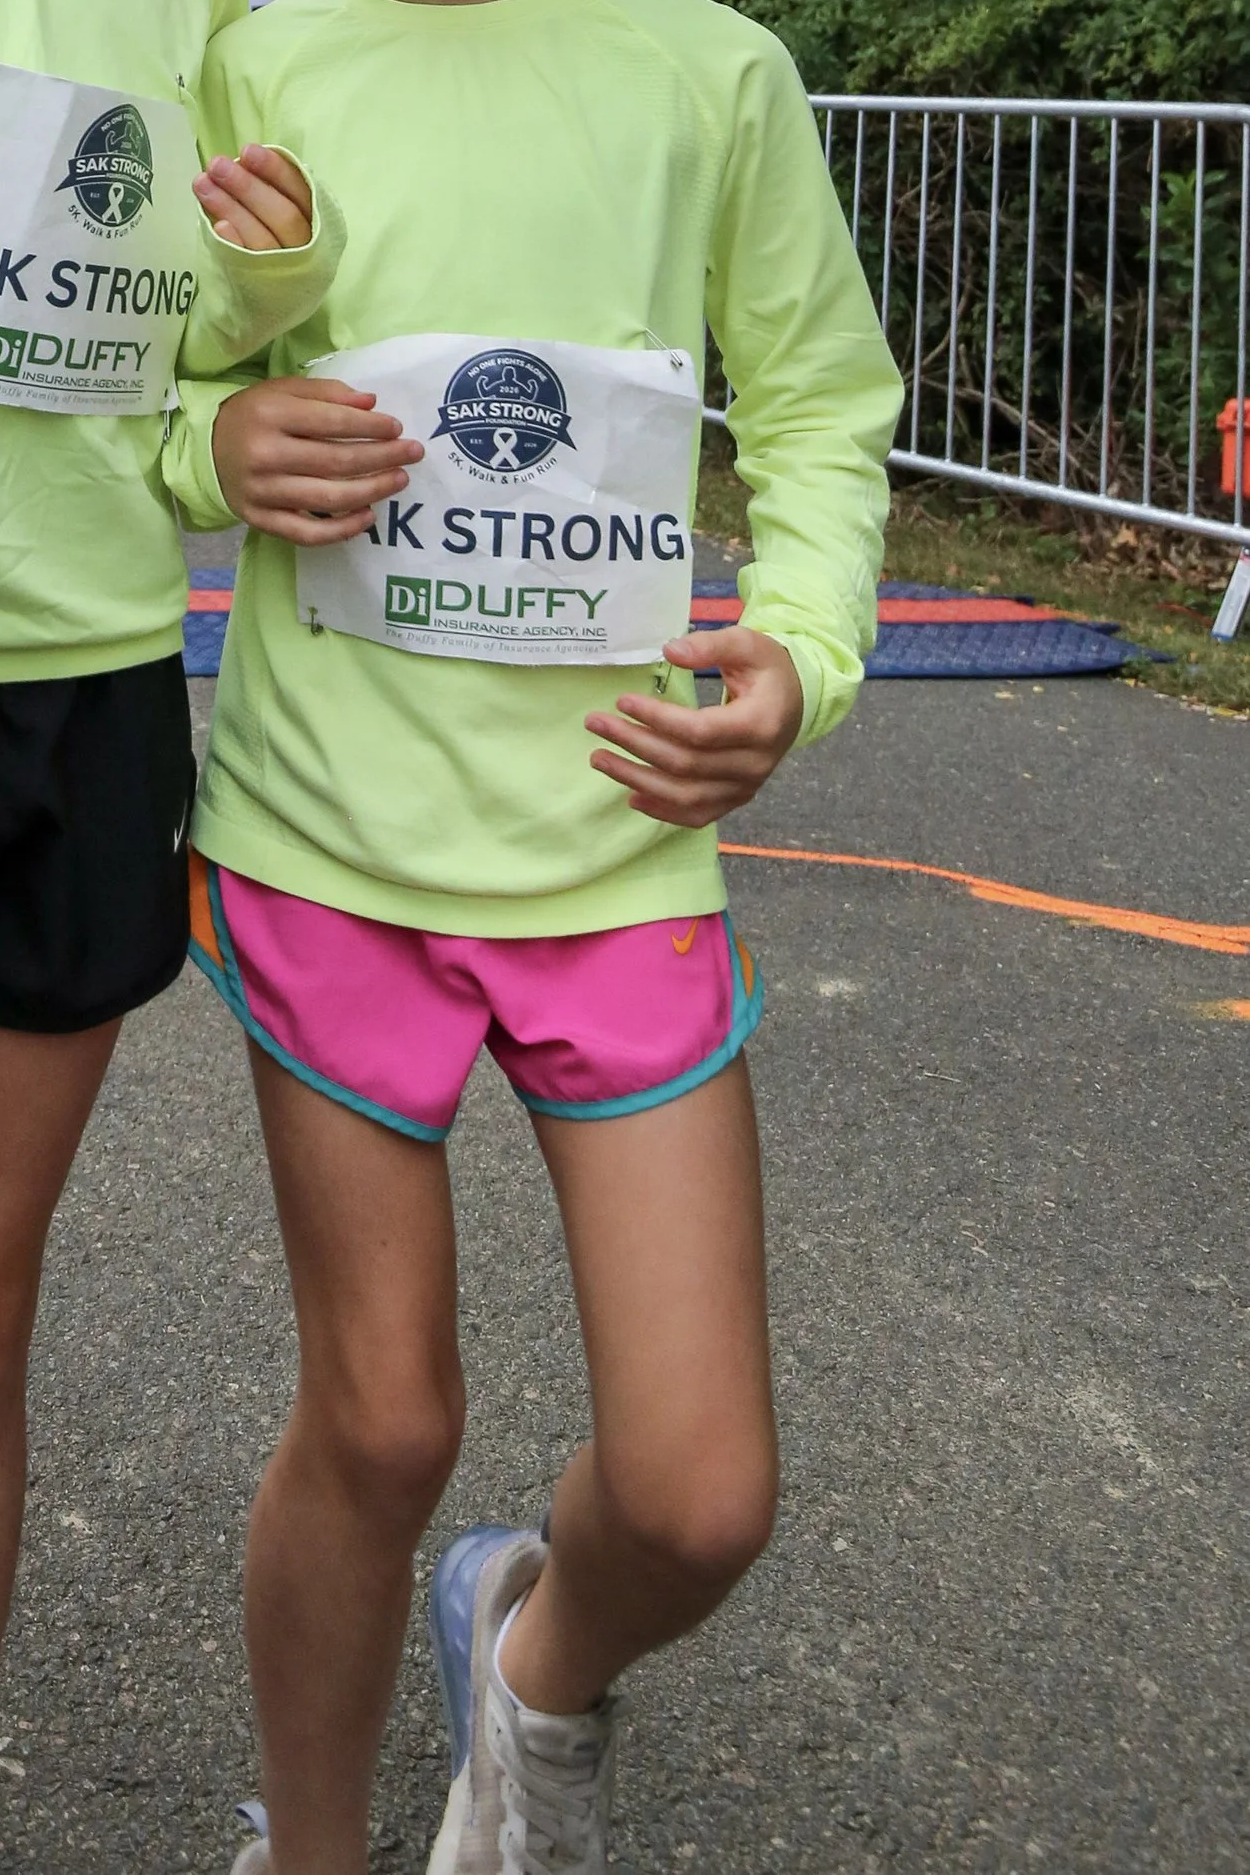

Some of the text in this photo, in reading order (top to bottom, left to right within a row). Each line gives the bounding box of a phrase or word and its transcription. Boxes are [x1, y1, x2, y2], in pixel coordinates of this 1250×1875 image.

[76, 157, 150, 184] SAK STRONG
[83, 219, 103, 236] Walk
[45, 259, 193, 316] STRONG
[27, 332, 151, 371] DUFFY
[22, 371, 90, 388] INSURANCE
[467, 357, 547, 382] NO ONE FIGHTS ALONE
[447, 402, 562, 427] SAK STRONG
[448, 451, 557, 484] 5K, Walk & Fun Run
[442, 507, 685, 561] STRONG
[389, 579, 609, 620] Di DUFFY
[434, 619, 607, 637] INSURANCE AGENCY, INC.
[407, 631, 436, 646] Duffy
[442, 635, 480, 649] Family
[484, 641, 495, 651] of
[499, 642, 551, 653] Insurance
